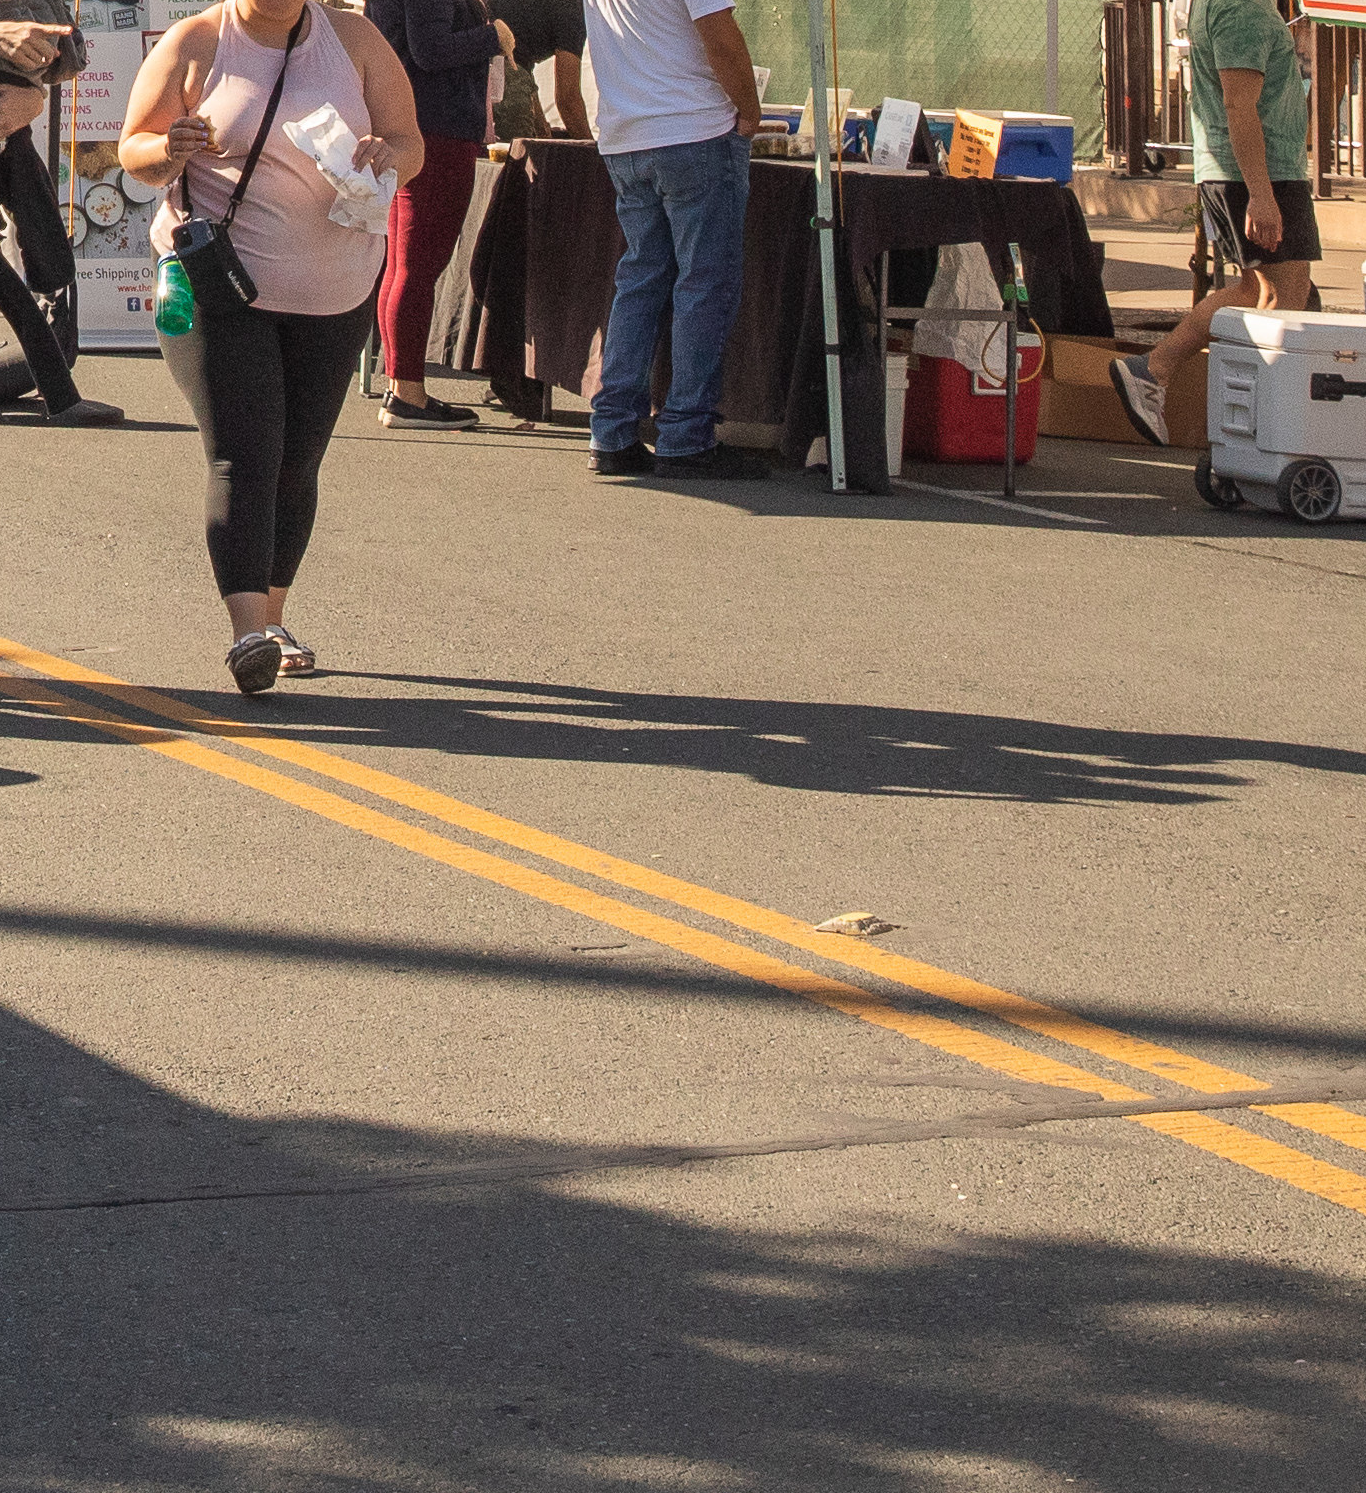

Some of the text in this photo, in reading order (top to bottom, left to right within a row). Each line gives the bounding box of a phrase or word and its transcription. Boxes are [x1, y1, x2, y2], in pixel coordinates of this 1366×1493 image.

[78, 72, 114, 82] SCRUBS
[85, 88, 110, 98] SHEA
[95, 121, 124, 131] CAND
[76, 270, 93, 280] ree
[95, 267, 139, 282] Shipping
[117, 283, 152, 292] www.the
